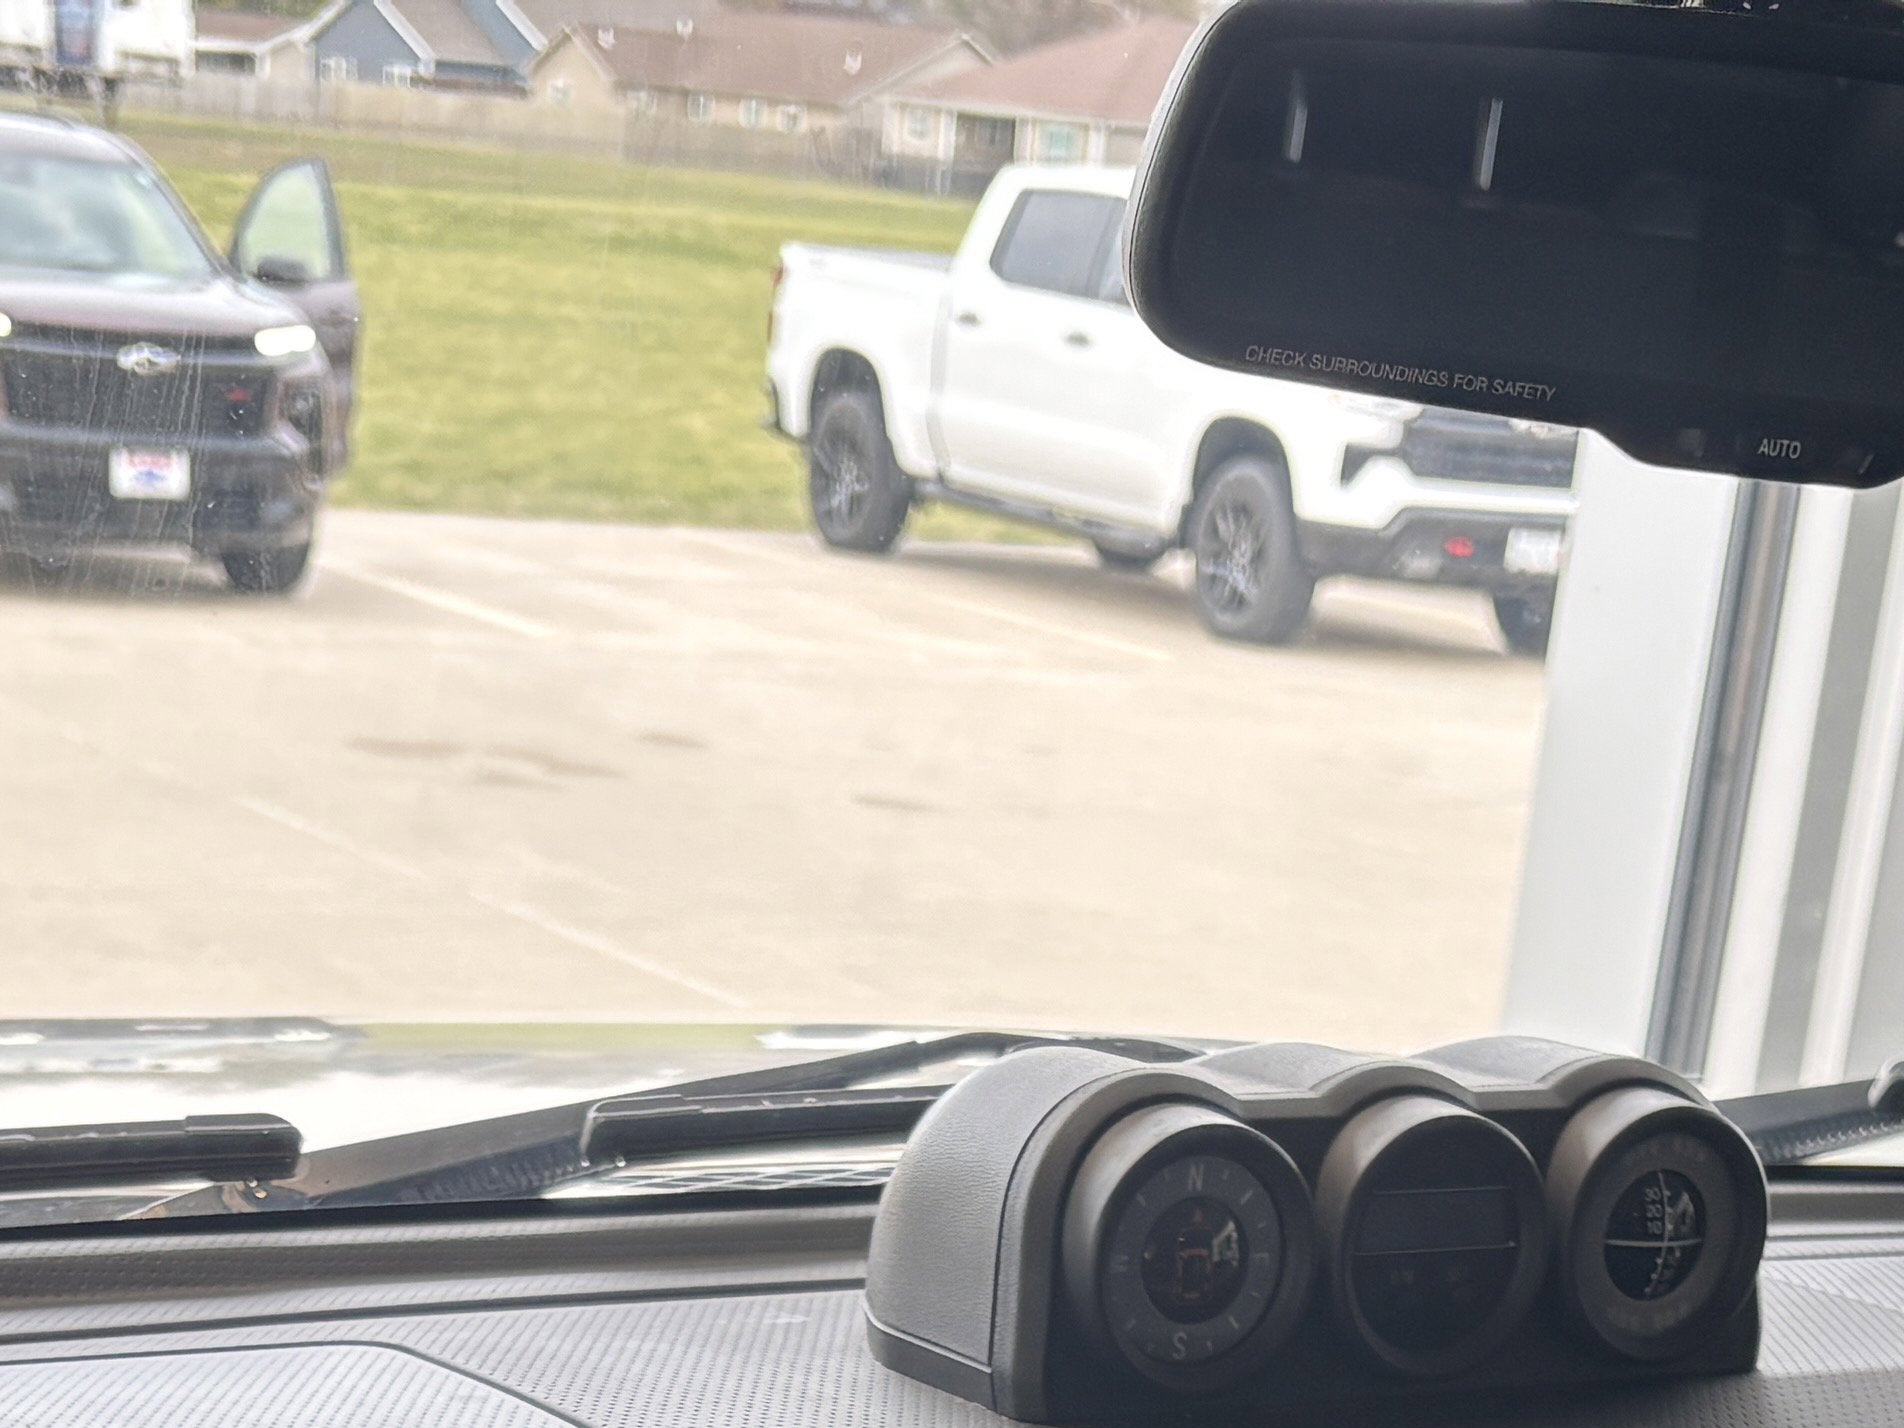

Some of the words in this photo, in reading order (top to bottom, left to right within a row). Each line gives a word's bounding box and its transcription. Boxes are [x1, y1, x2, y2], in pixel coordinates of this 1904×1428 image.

[1246, 345, 1307, 368] CHECK
[1309, 352, 1446, 388] SURROUNDINGS
[1453, 372, 1488, 392] FOR
[1492, 378, 1558, 402] SAFETY
[1756, 437, 1802, 460] AUTO
